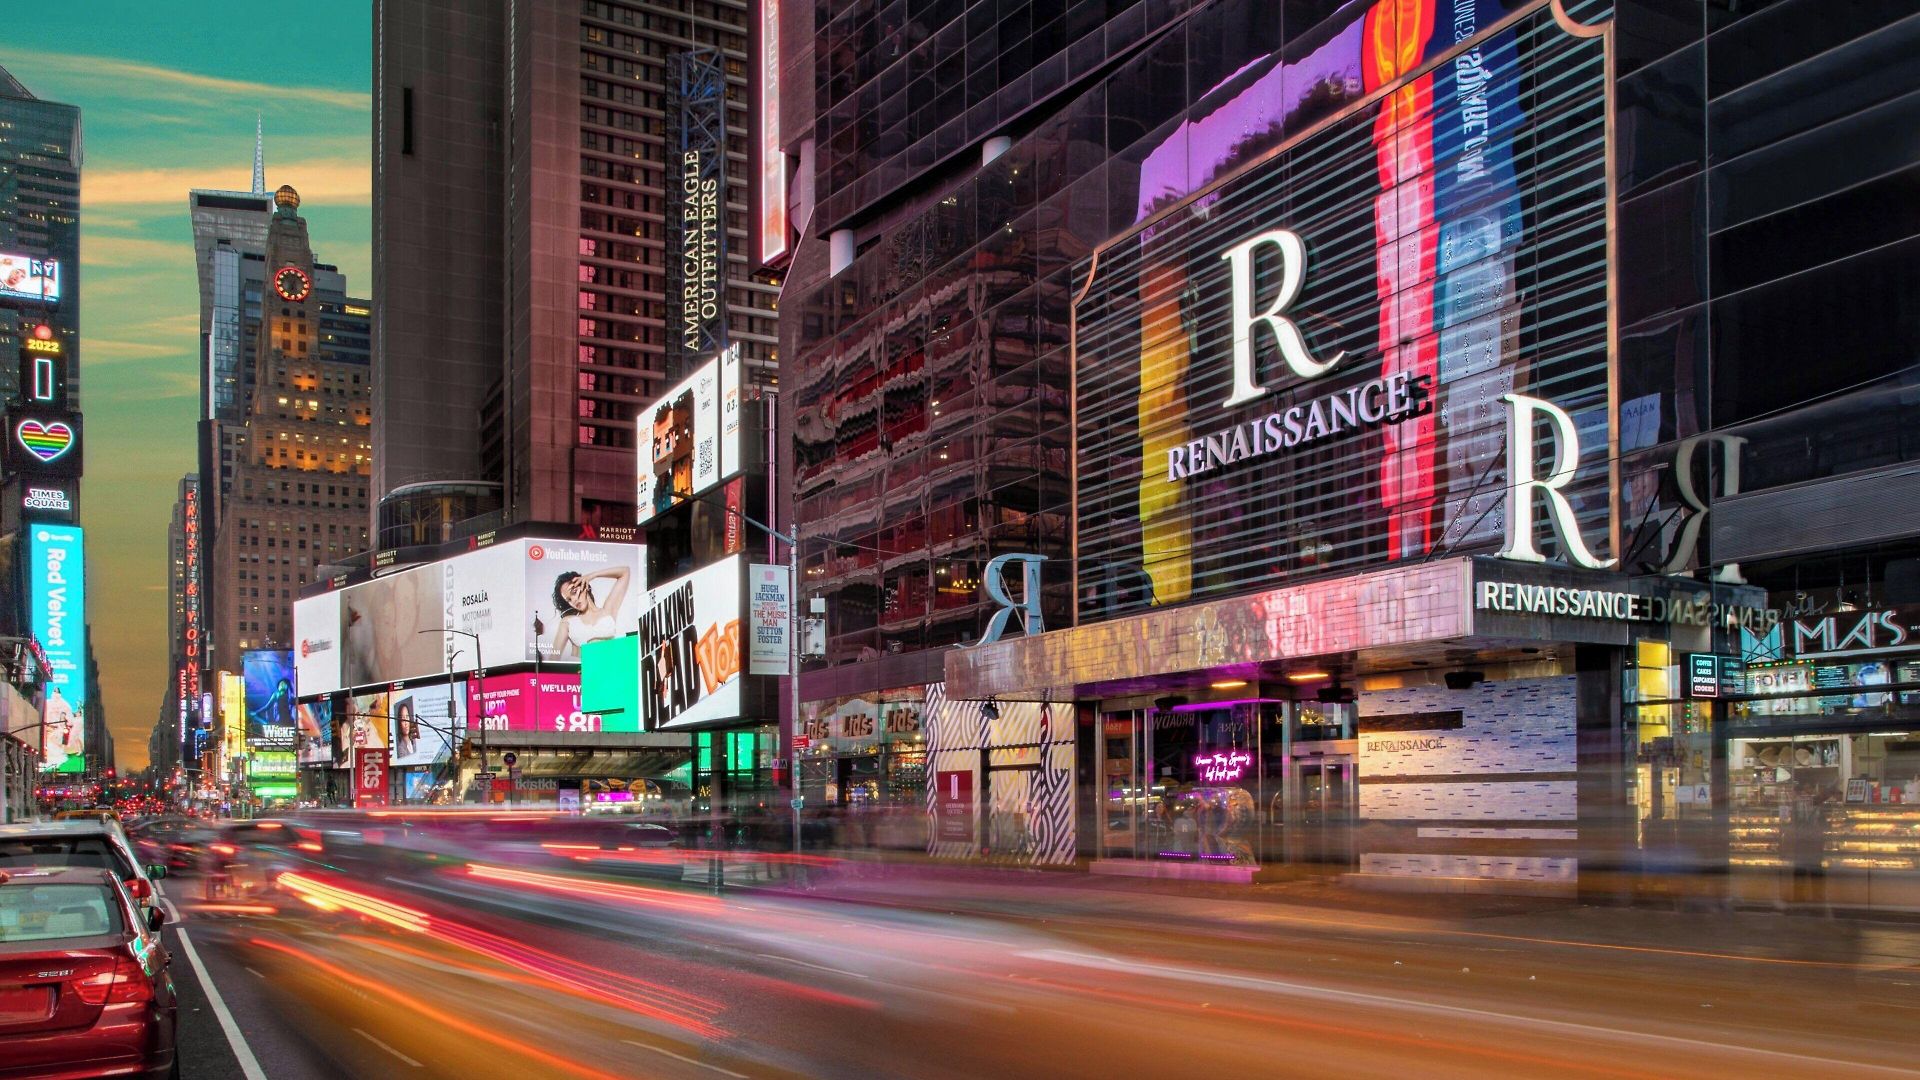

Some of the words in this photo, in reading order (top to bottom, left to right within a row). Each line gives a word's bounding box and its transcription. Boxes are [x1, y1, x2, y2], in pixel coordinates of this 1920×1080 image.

[684, 150, 699, 225] EAGLE
[701, 179, 717, 320] OUTFITTERS
[684, 230, 699, 352] AMERICAN
[1220, 229, 1350, 408] R
[28, 339, 59, 353] 2022
[1167, 371, 1414, 484] RENAISSANCE
[1503, 393, 1618, 570] R
[30, 488, 64, 500] TIMES
[24, 498, 69, 510] SQUARE
[599, 533, 633, 541] MARQUIS
[545, 548, 580, 560] YouTube
[580, 550, 608, 562] Music
[48, 547, 66, 585] Red
[760, 585, 779, 593] HUGH
[755, 592, 785, 602] JACKMAN
[1480, 581, 1640, 620] RENAISSANCE
[48, 587, 66, 647] Velvet
[638, 580, 695, 659] WALKING
[754, 610, 766, 618] THE
[767, 610, 787, 620] MUSIC
[762, 619, 778, 627] MAN
[757, 627, 784, 636] SUTTON
[1794, 610, 1908, 654] MIA'S
[757, 635, 782, 644] FOSTER
[541, 684, 566, 692] WE'LL
[1367, 739, 1444, 752] RENAISSANCE
[363, 751, 384, 789] tkts
